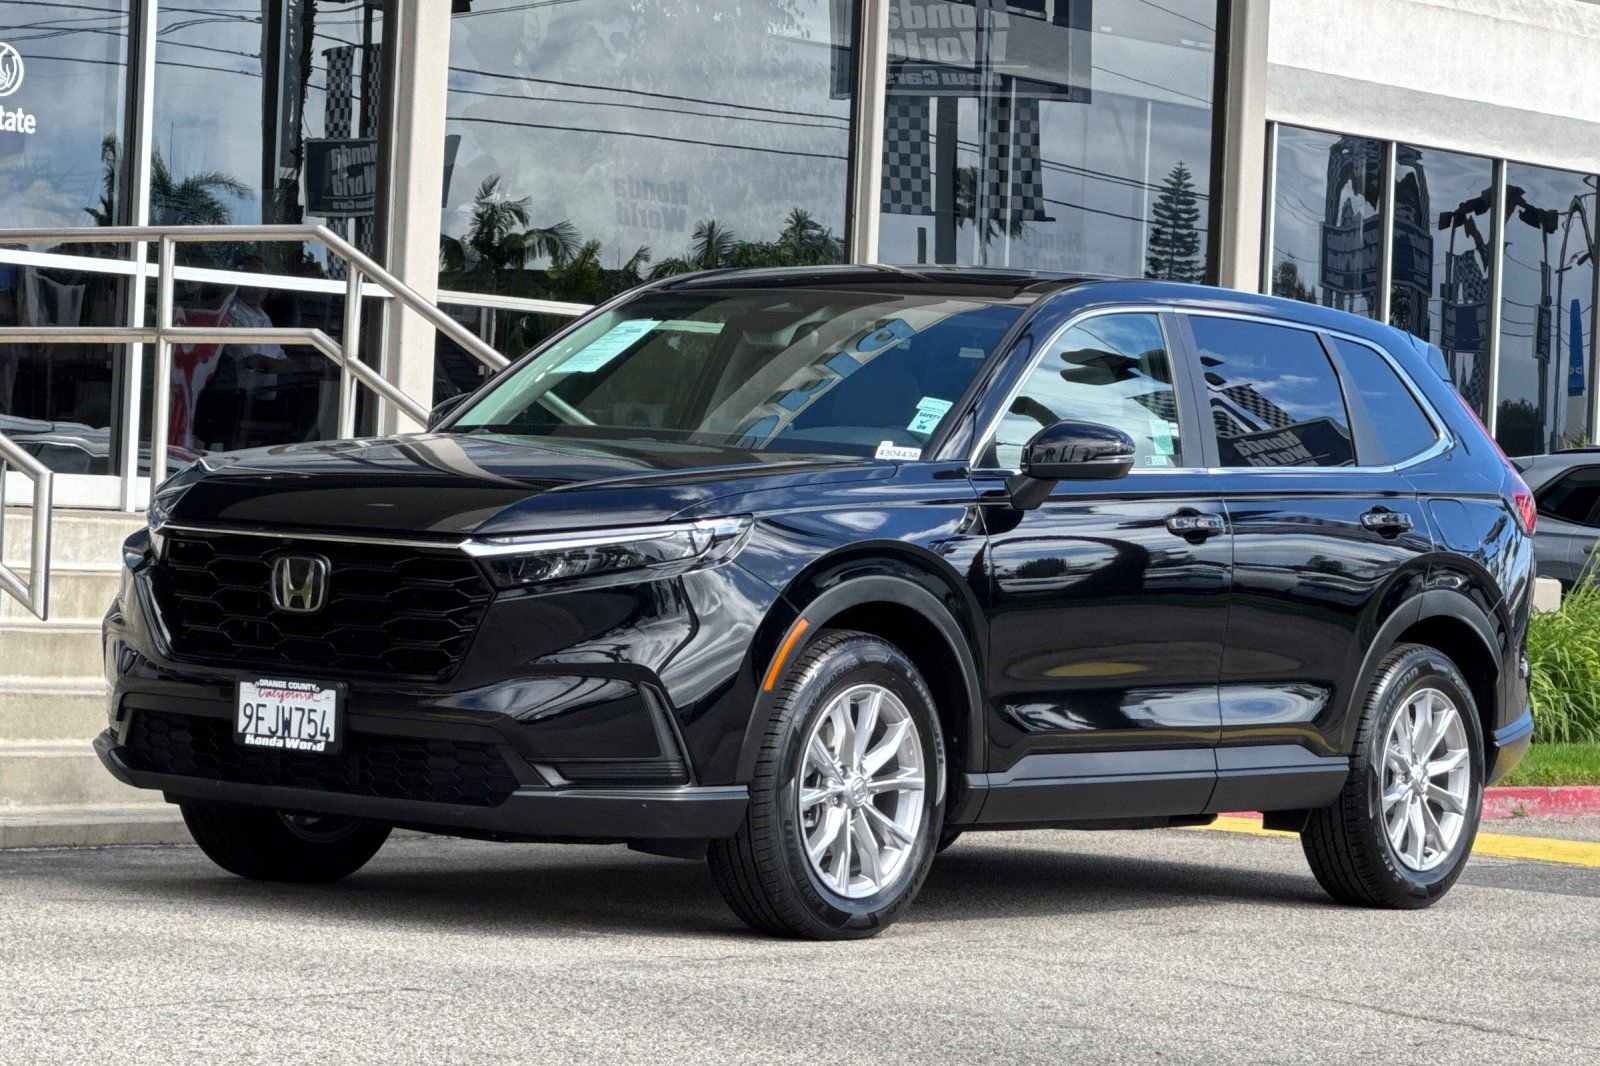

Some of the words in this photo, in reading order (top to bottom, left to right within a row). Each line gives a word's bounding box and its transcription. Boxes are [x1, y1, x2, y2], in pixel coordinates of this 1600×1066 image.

[258, 679, 287, 689] ORANGE
[288, 681, 316, 691] COUNTY
[258, 687, 316, 704] California
[241, 702, 331, 741] 9FJW754
[244, 734, 284, 749] Honda
